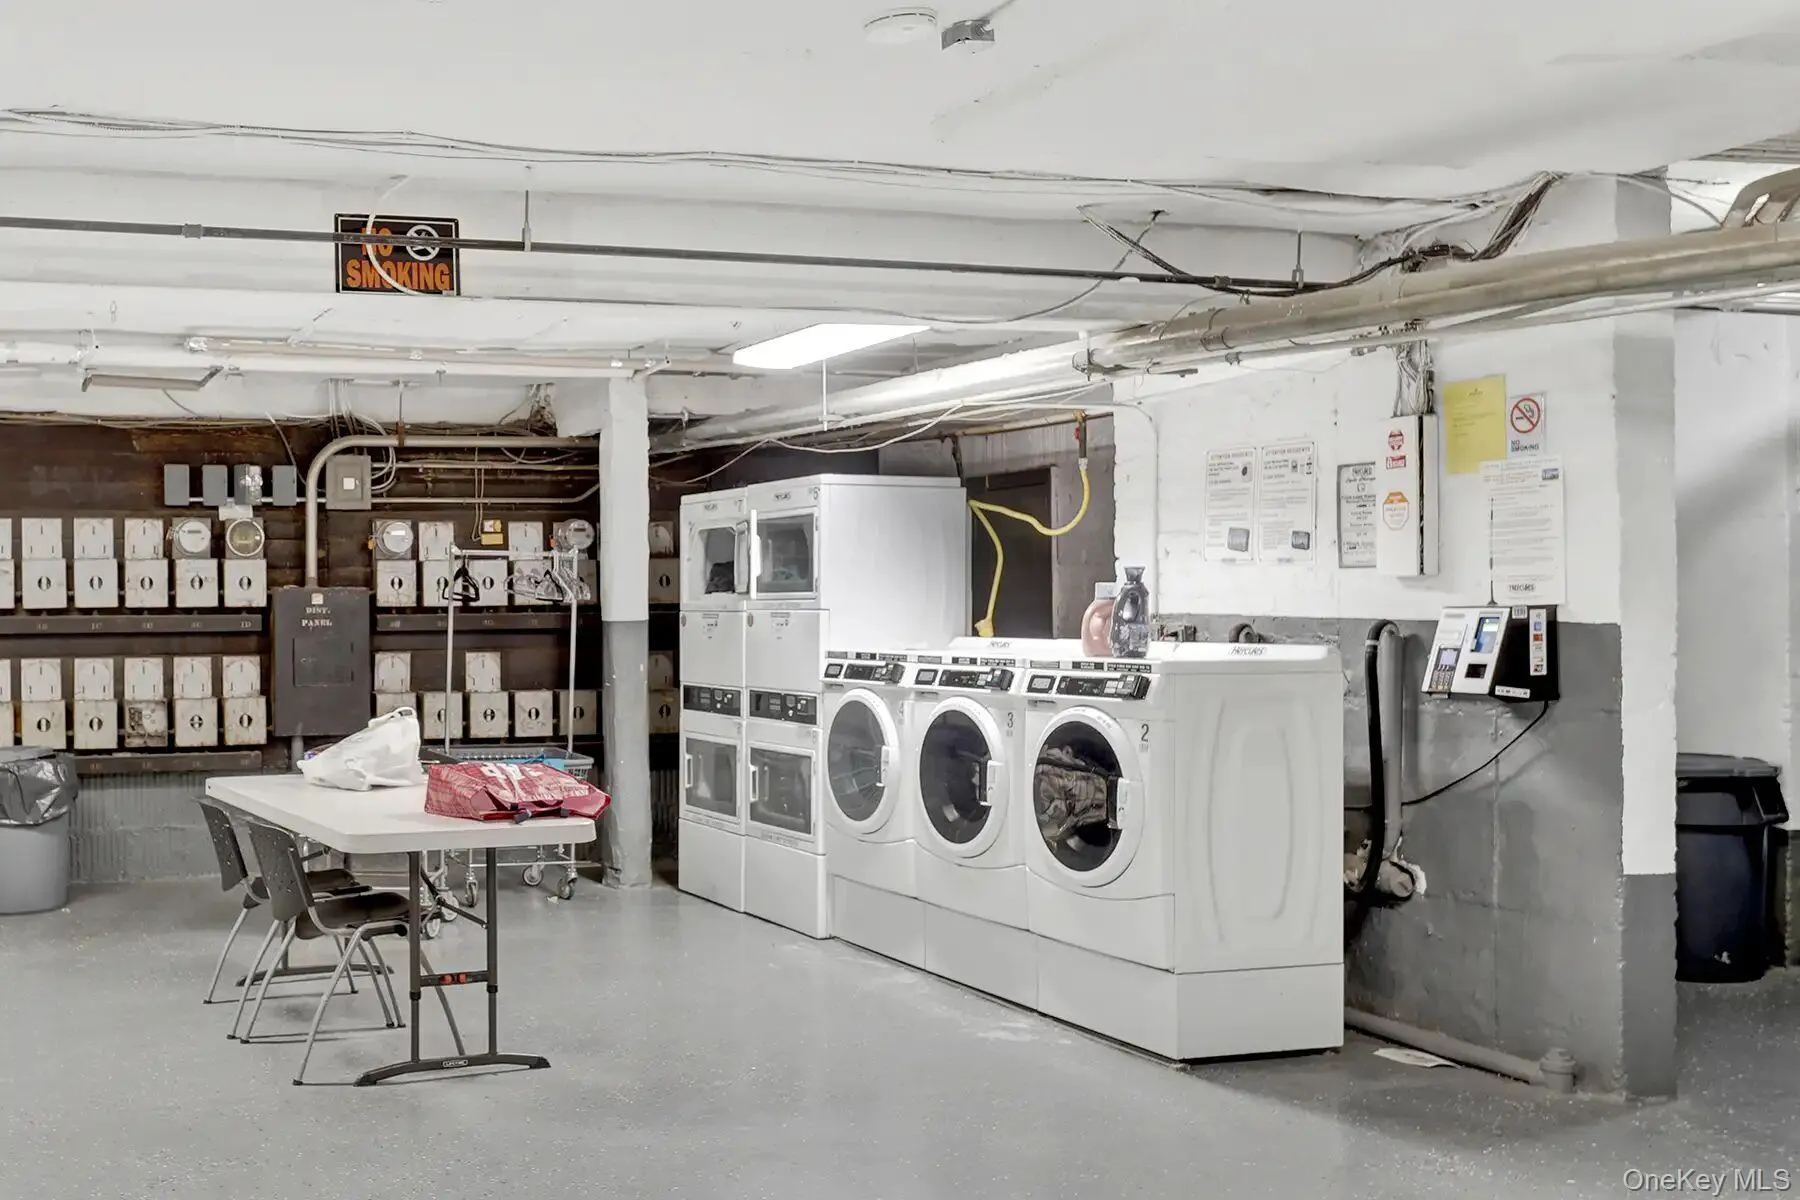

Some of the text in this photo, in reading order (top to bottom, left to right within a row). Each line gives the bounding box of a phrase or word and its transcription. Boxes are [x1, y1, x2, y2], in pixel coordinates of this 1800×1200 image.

[346, 258, 451, 290] SMOKING
[1007, 711, 1014, 729] 3
[1141, 723, 1150, 743] 2
